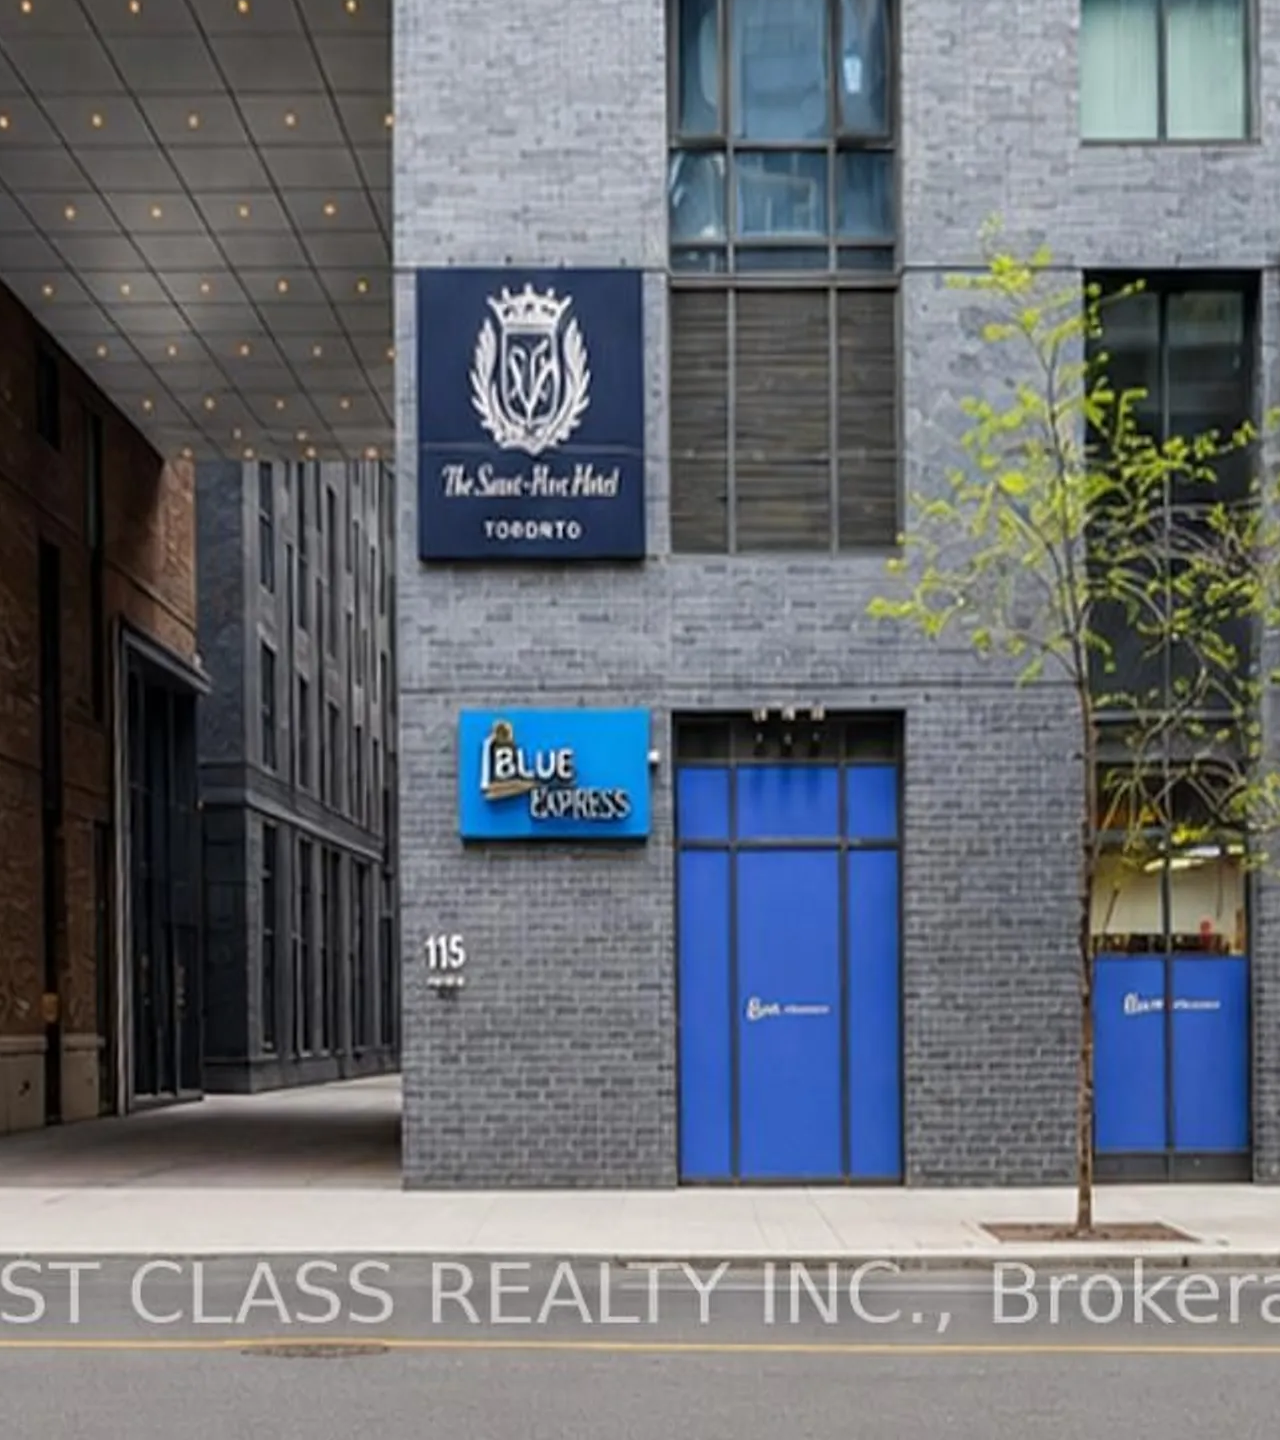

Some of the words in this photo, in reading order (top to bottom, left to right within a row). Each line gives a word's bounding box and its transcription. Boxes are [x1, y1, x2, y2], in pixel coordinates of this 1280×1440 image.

[441, 463, 473, 497] The
[484, 520, 582, 540] TORONTO
[530, 786, 631, 819] EXPRESS
[424, 933, 467, 970] 115
